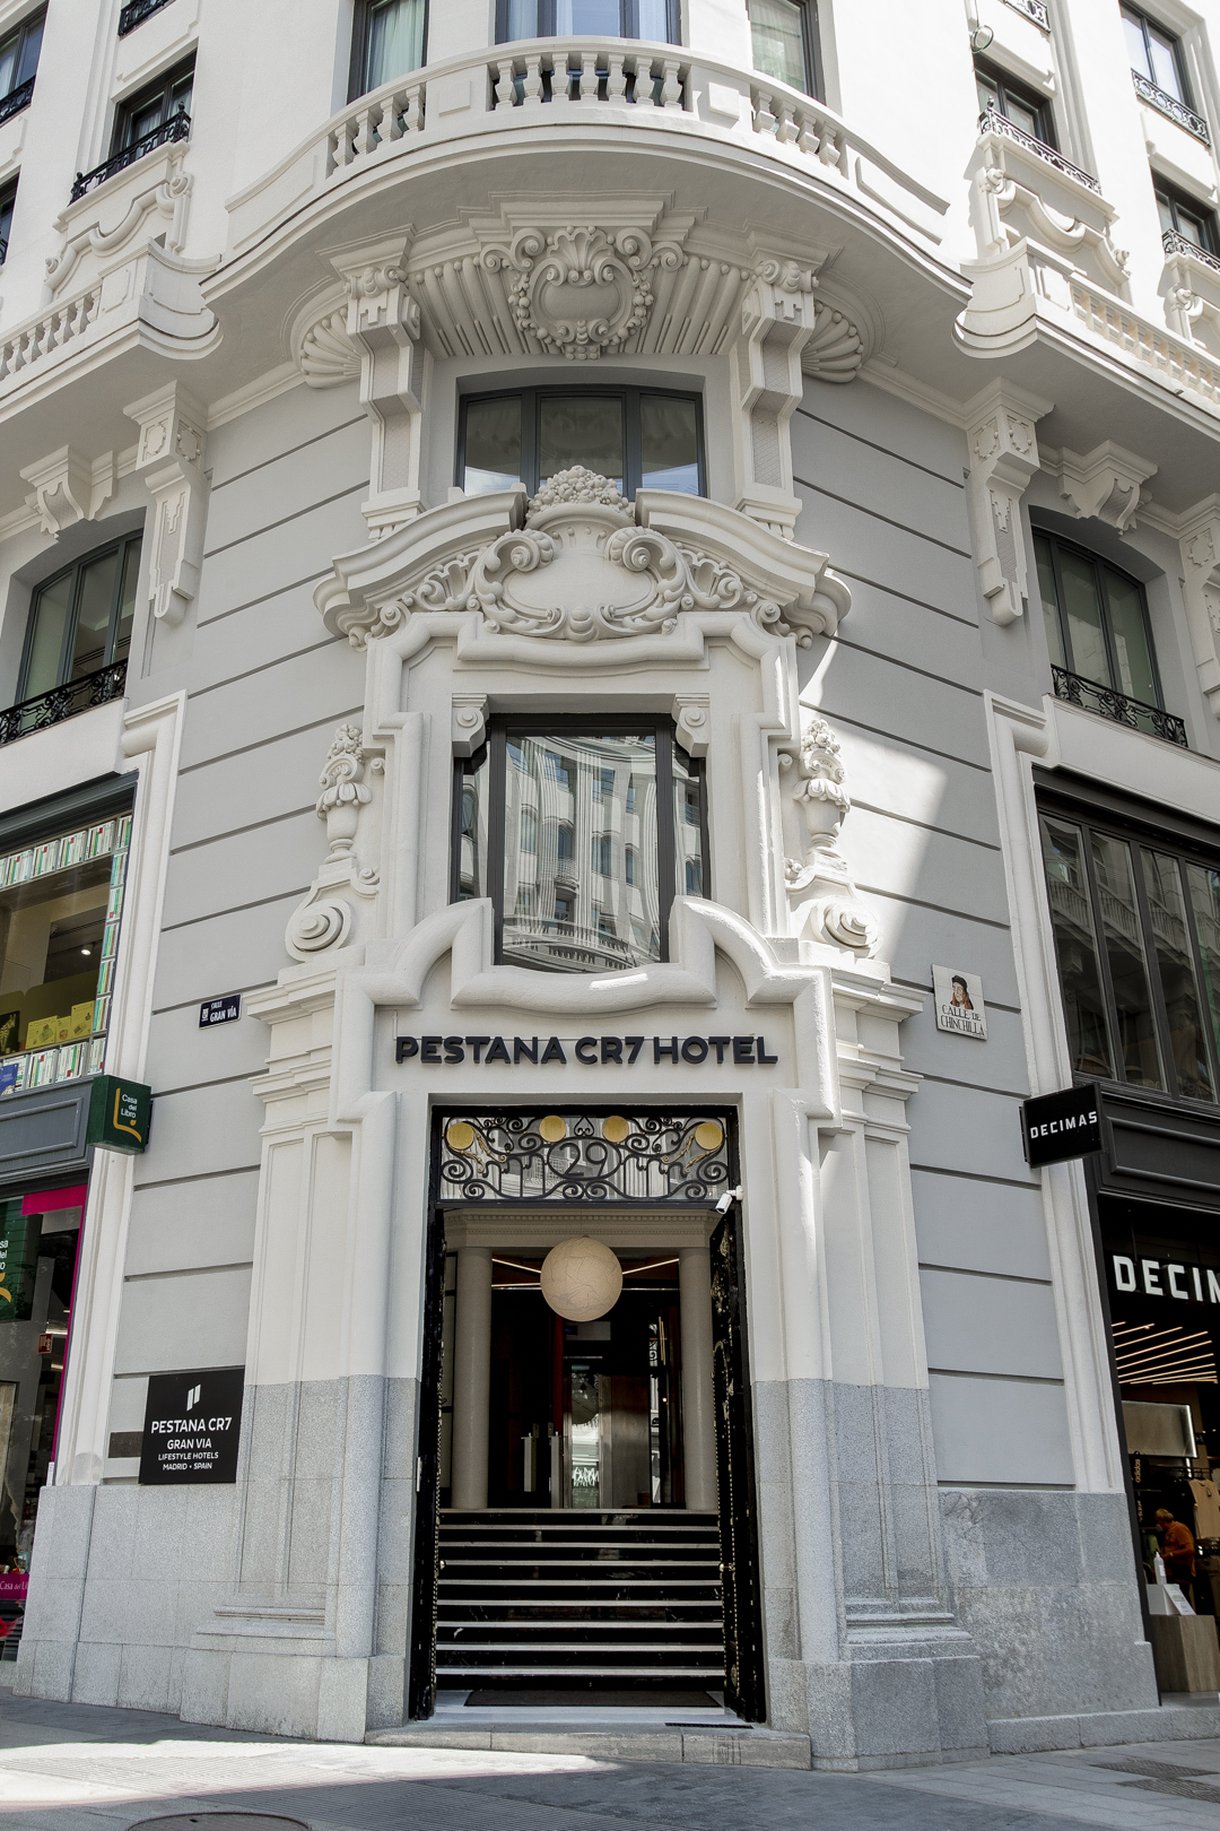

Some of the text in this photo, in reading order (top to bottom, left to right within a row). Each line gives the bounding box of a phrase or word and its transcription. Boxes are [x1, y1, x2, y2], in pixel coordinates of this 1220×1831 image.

[210, 1010, 226, 1022] GRAN
[942, 1004, 981, 1021] CALLE DE
[941, 1014, 985, 1036] CHINCHILLA
[395, 1036, 778, 1064] PESTANA CR7 HOTEL
[122, 1094, 138, 1104] Casa
[121, 1108, 136, 1118] Libro
[1030, 1111, 1098, 1139] DECIMAS
[562, 1142, 609, 1176] 29
[151, 1417, 232, 1434] PESTANA CR7
[167, 1438, 212, 1450] GRAN VIA
[158, 1451, 219, 1461] LIFESTYLE HOTELS
[163, 1462, 213, 1471] MADRID SPAIN
